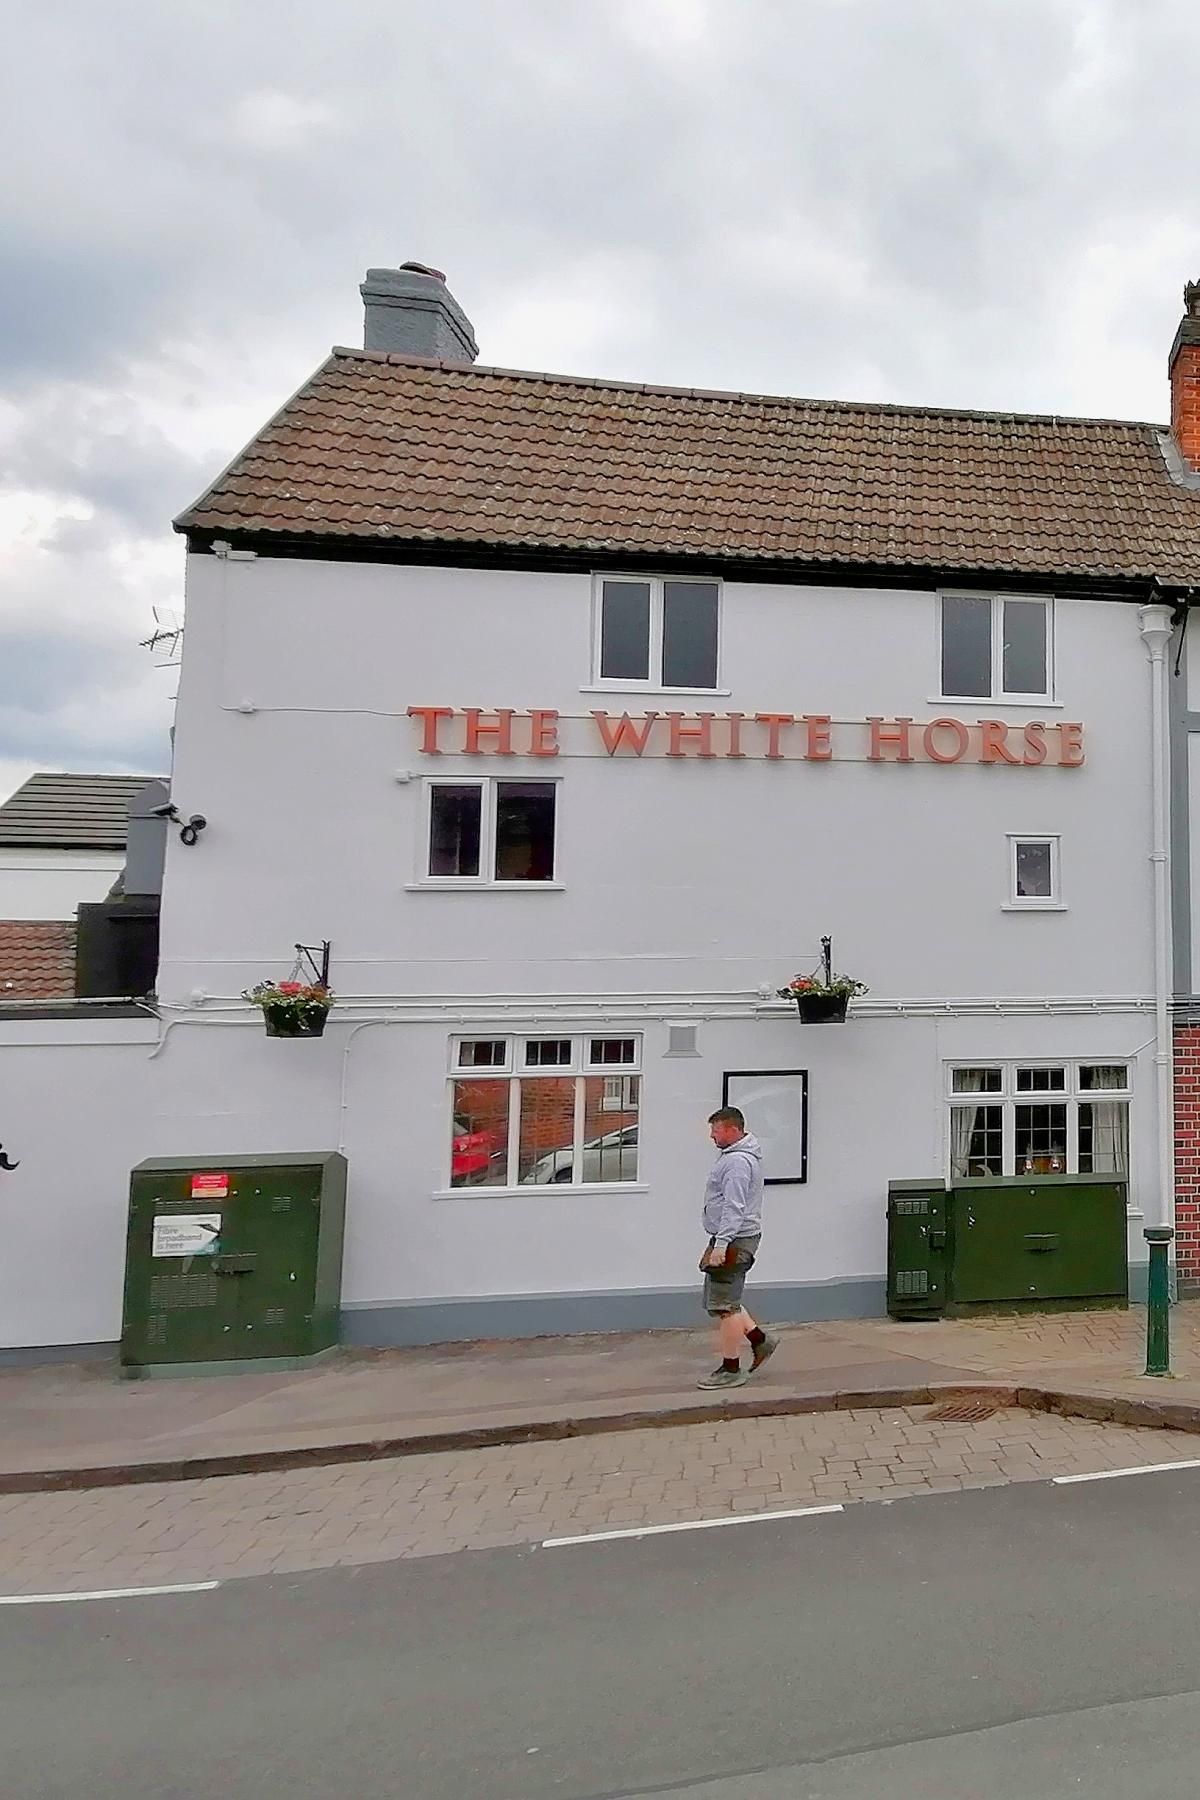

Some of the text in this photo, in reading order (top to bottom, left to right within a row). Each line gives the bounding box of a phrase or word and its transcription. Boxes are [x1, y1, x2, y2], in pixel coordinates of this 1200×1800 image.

[407, 706, 1086, 766] THE WHITE HORSE
